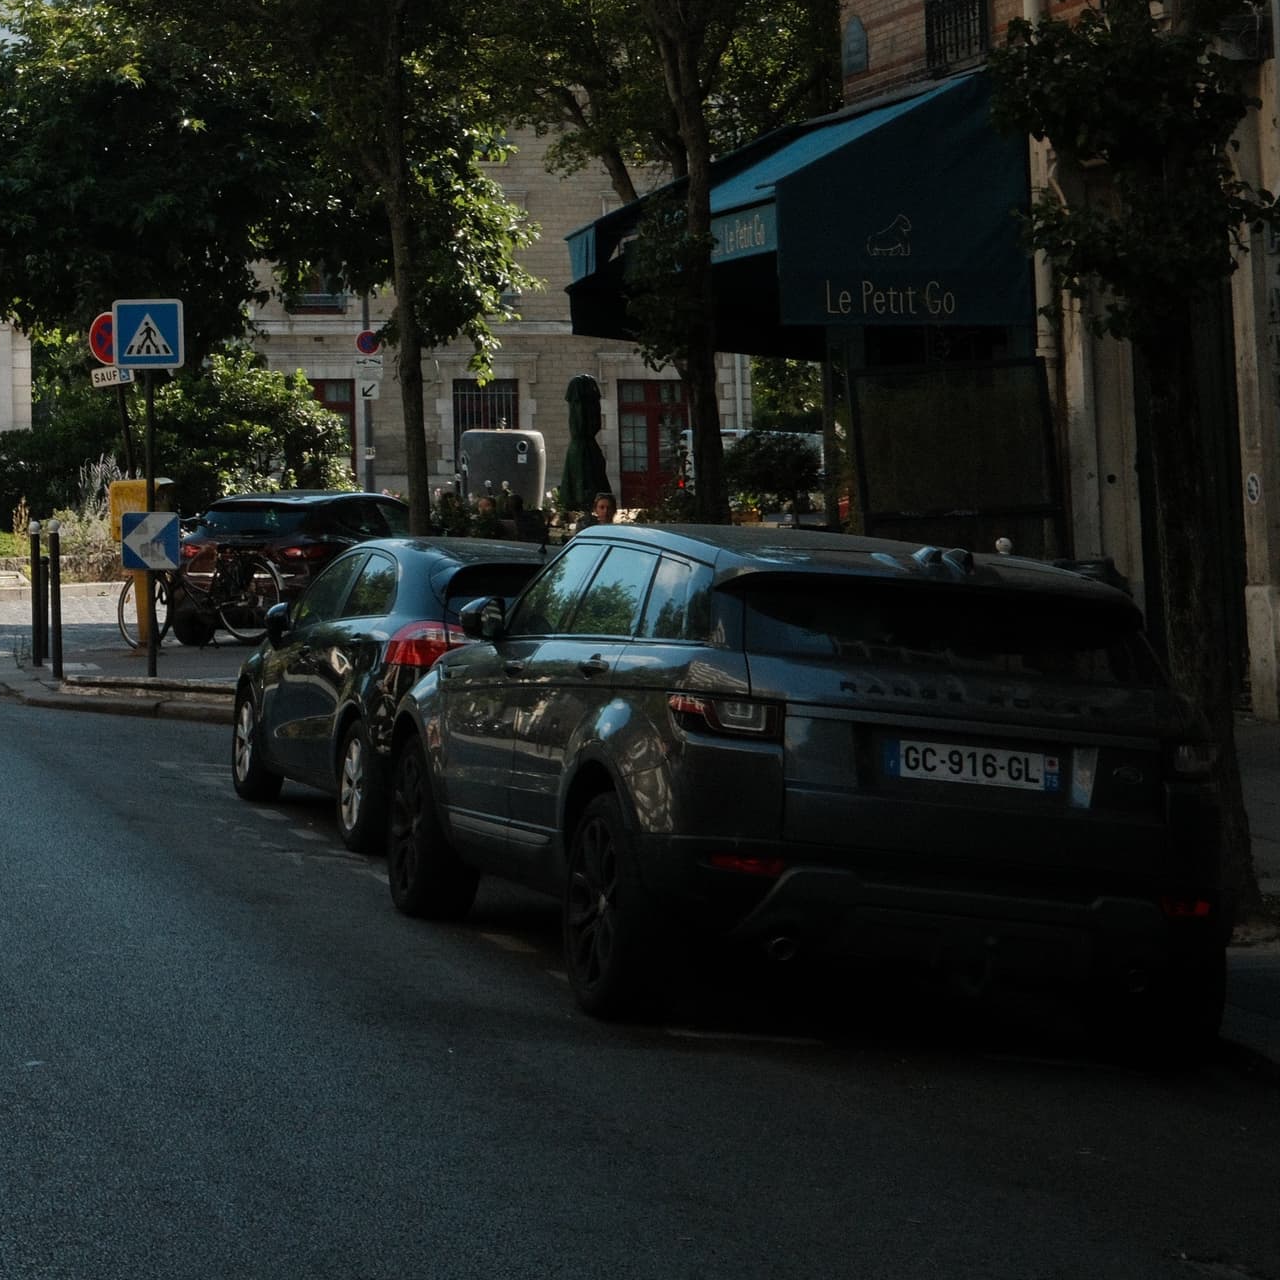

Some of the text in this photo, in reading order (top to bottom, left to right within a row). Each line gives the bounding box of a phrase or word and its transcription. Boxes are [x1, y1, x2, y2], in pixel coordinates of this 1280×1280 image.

[825, 279, 956, 315] Le Petit Go
[94, 370, 118, 383] SAUF
[904, 745, 1040, 784] GC-916-GL
